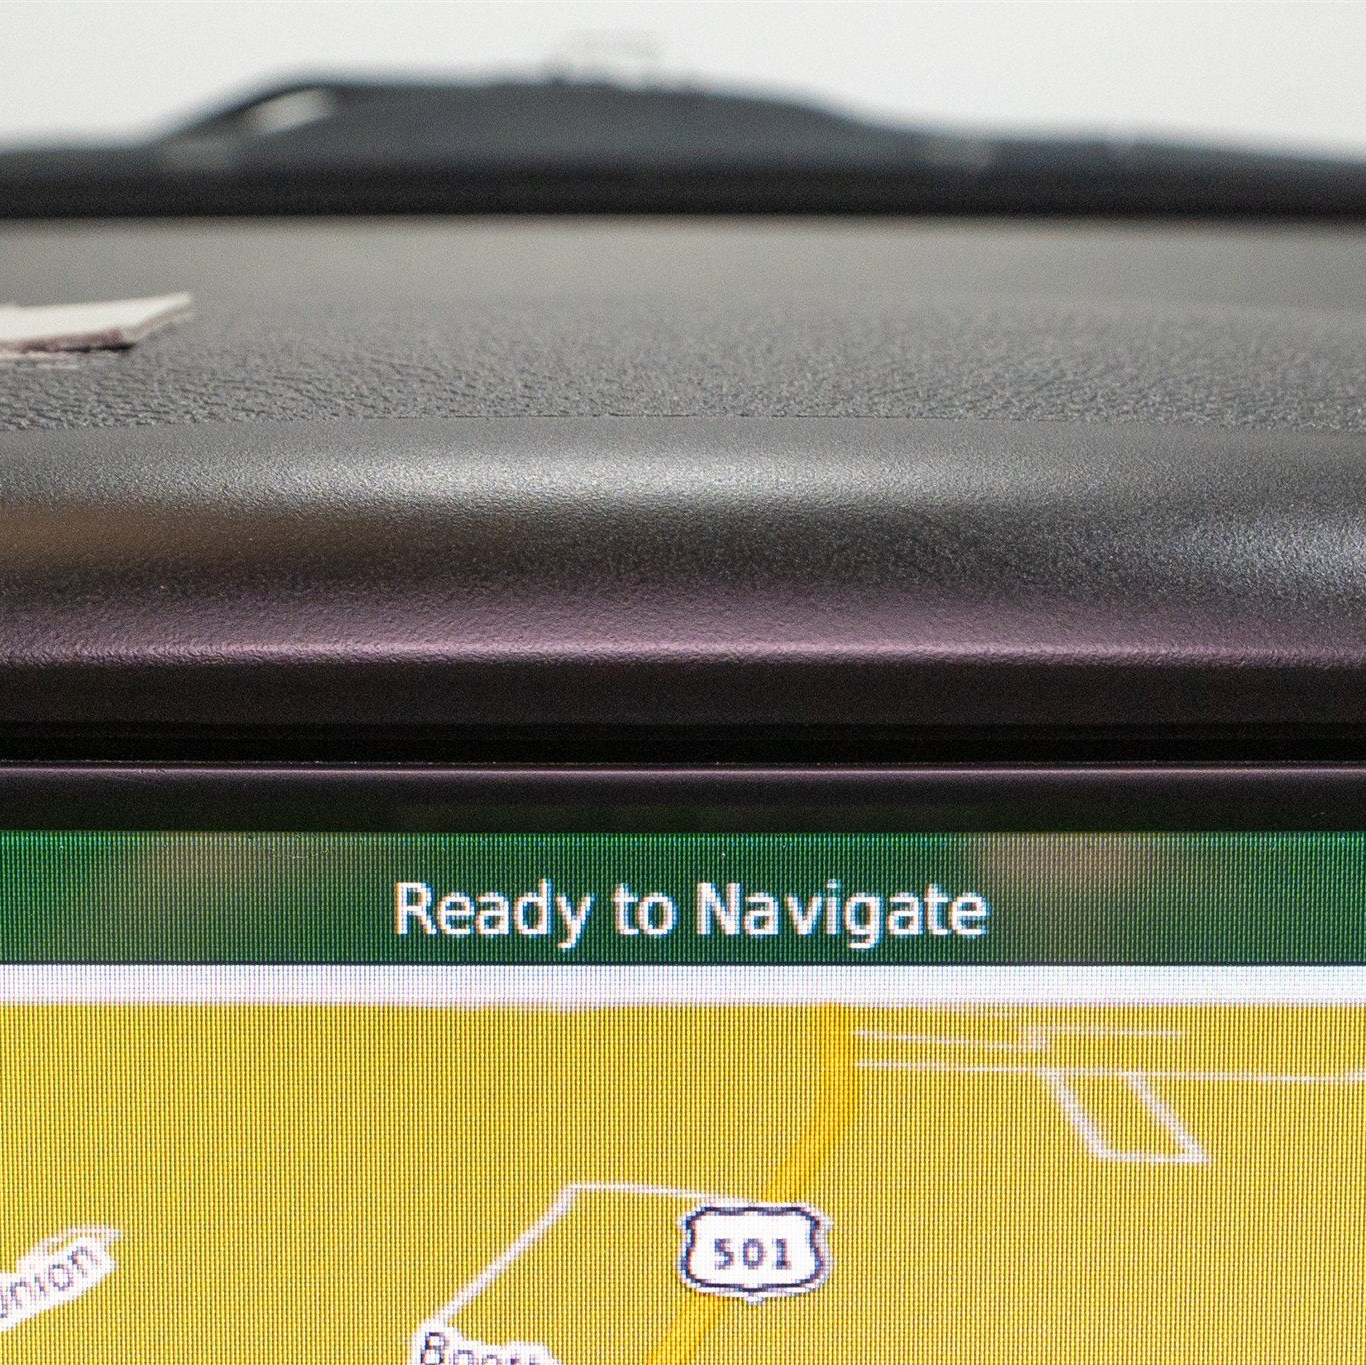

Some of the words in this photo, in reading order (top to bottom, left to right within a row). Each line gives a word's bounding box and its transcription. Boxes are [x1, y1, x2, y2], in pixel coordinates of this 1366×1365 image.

[393, 879, 593, 949] Ready
[613, 885, 678, 936] to
[695, 879, 989, 948] Navigate
[713, 1237, 793, 1270] 501
